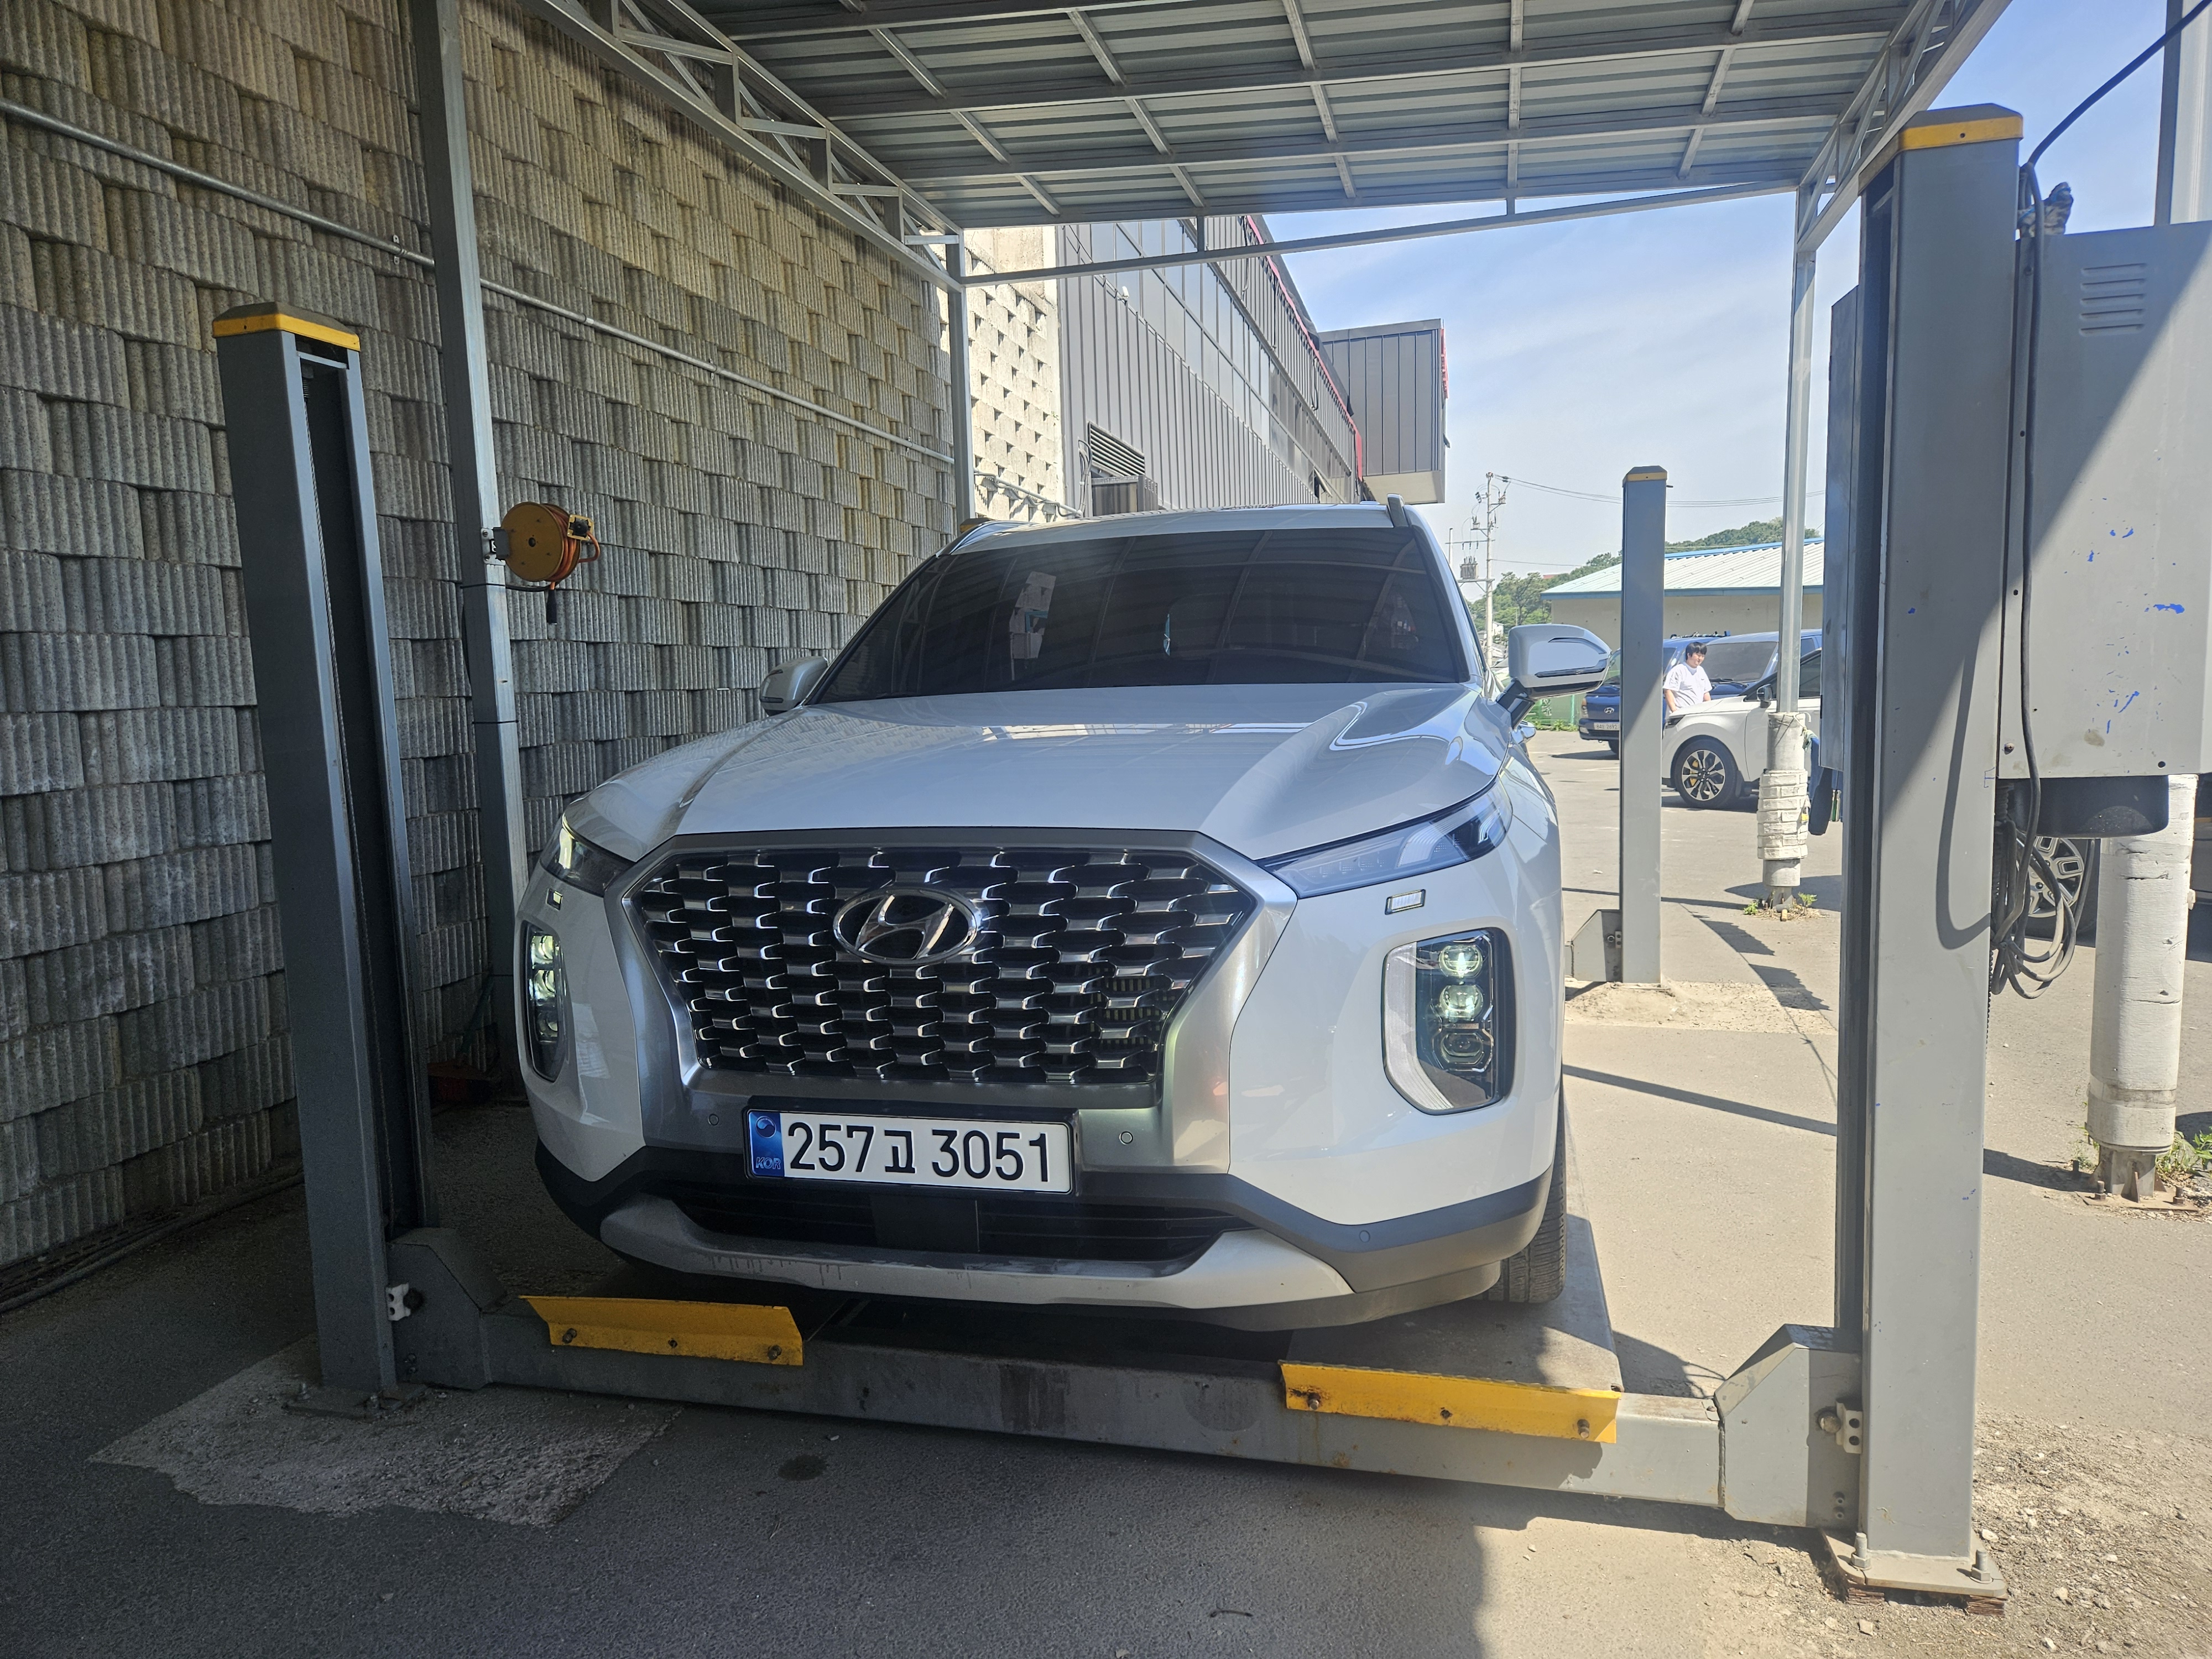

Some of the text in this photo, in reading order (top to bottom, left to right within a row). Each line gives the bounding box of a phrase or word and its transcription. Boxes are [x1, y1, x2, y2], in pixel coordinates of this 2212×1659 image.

[755, 1156, 781, 1170] KOR
[788, 1122, 1048, 1182] 257고 3051
